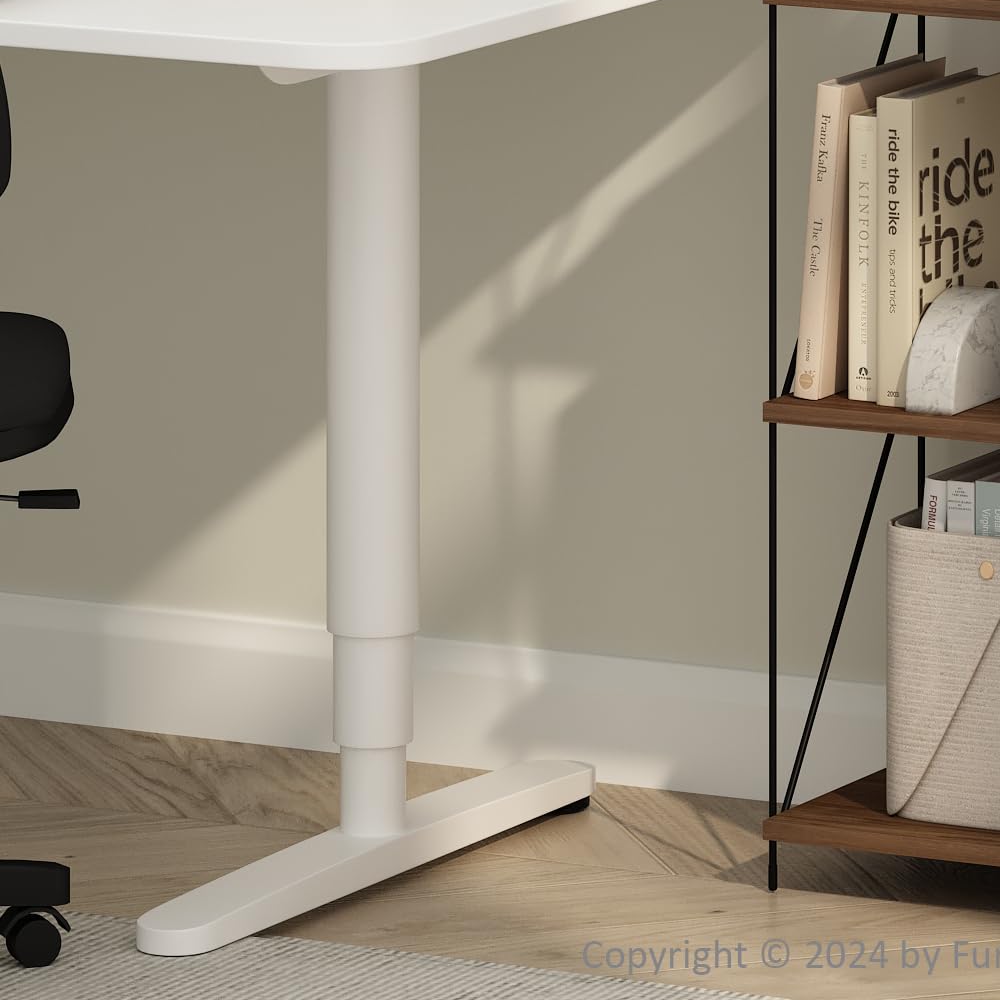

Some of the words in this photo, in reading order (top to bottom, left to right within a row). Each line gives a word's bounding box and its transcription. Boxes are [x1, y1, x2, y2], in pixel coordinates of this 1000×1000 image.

[819, 113, 832, 147] Franz
[887, 128, 900, 162] ride
[816, 149, 829, 183] Kafka
[887, 167, 900, 195] the
[918, 137, 995, 218] ride
[811, 218, 823, 242] The
[858, 181, 870, 267] KINFOLK
[887, 200, 900, 236] bike
[809, 243, 821, 278] Castle
[887, 249, 897, 266] tips
[918, 213, 985, 284] the
[888, 269, 897, 288] and
[888, 289, 898, 315] tricks
